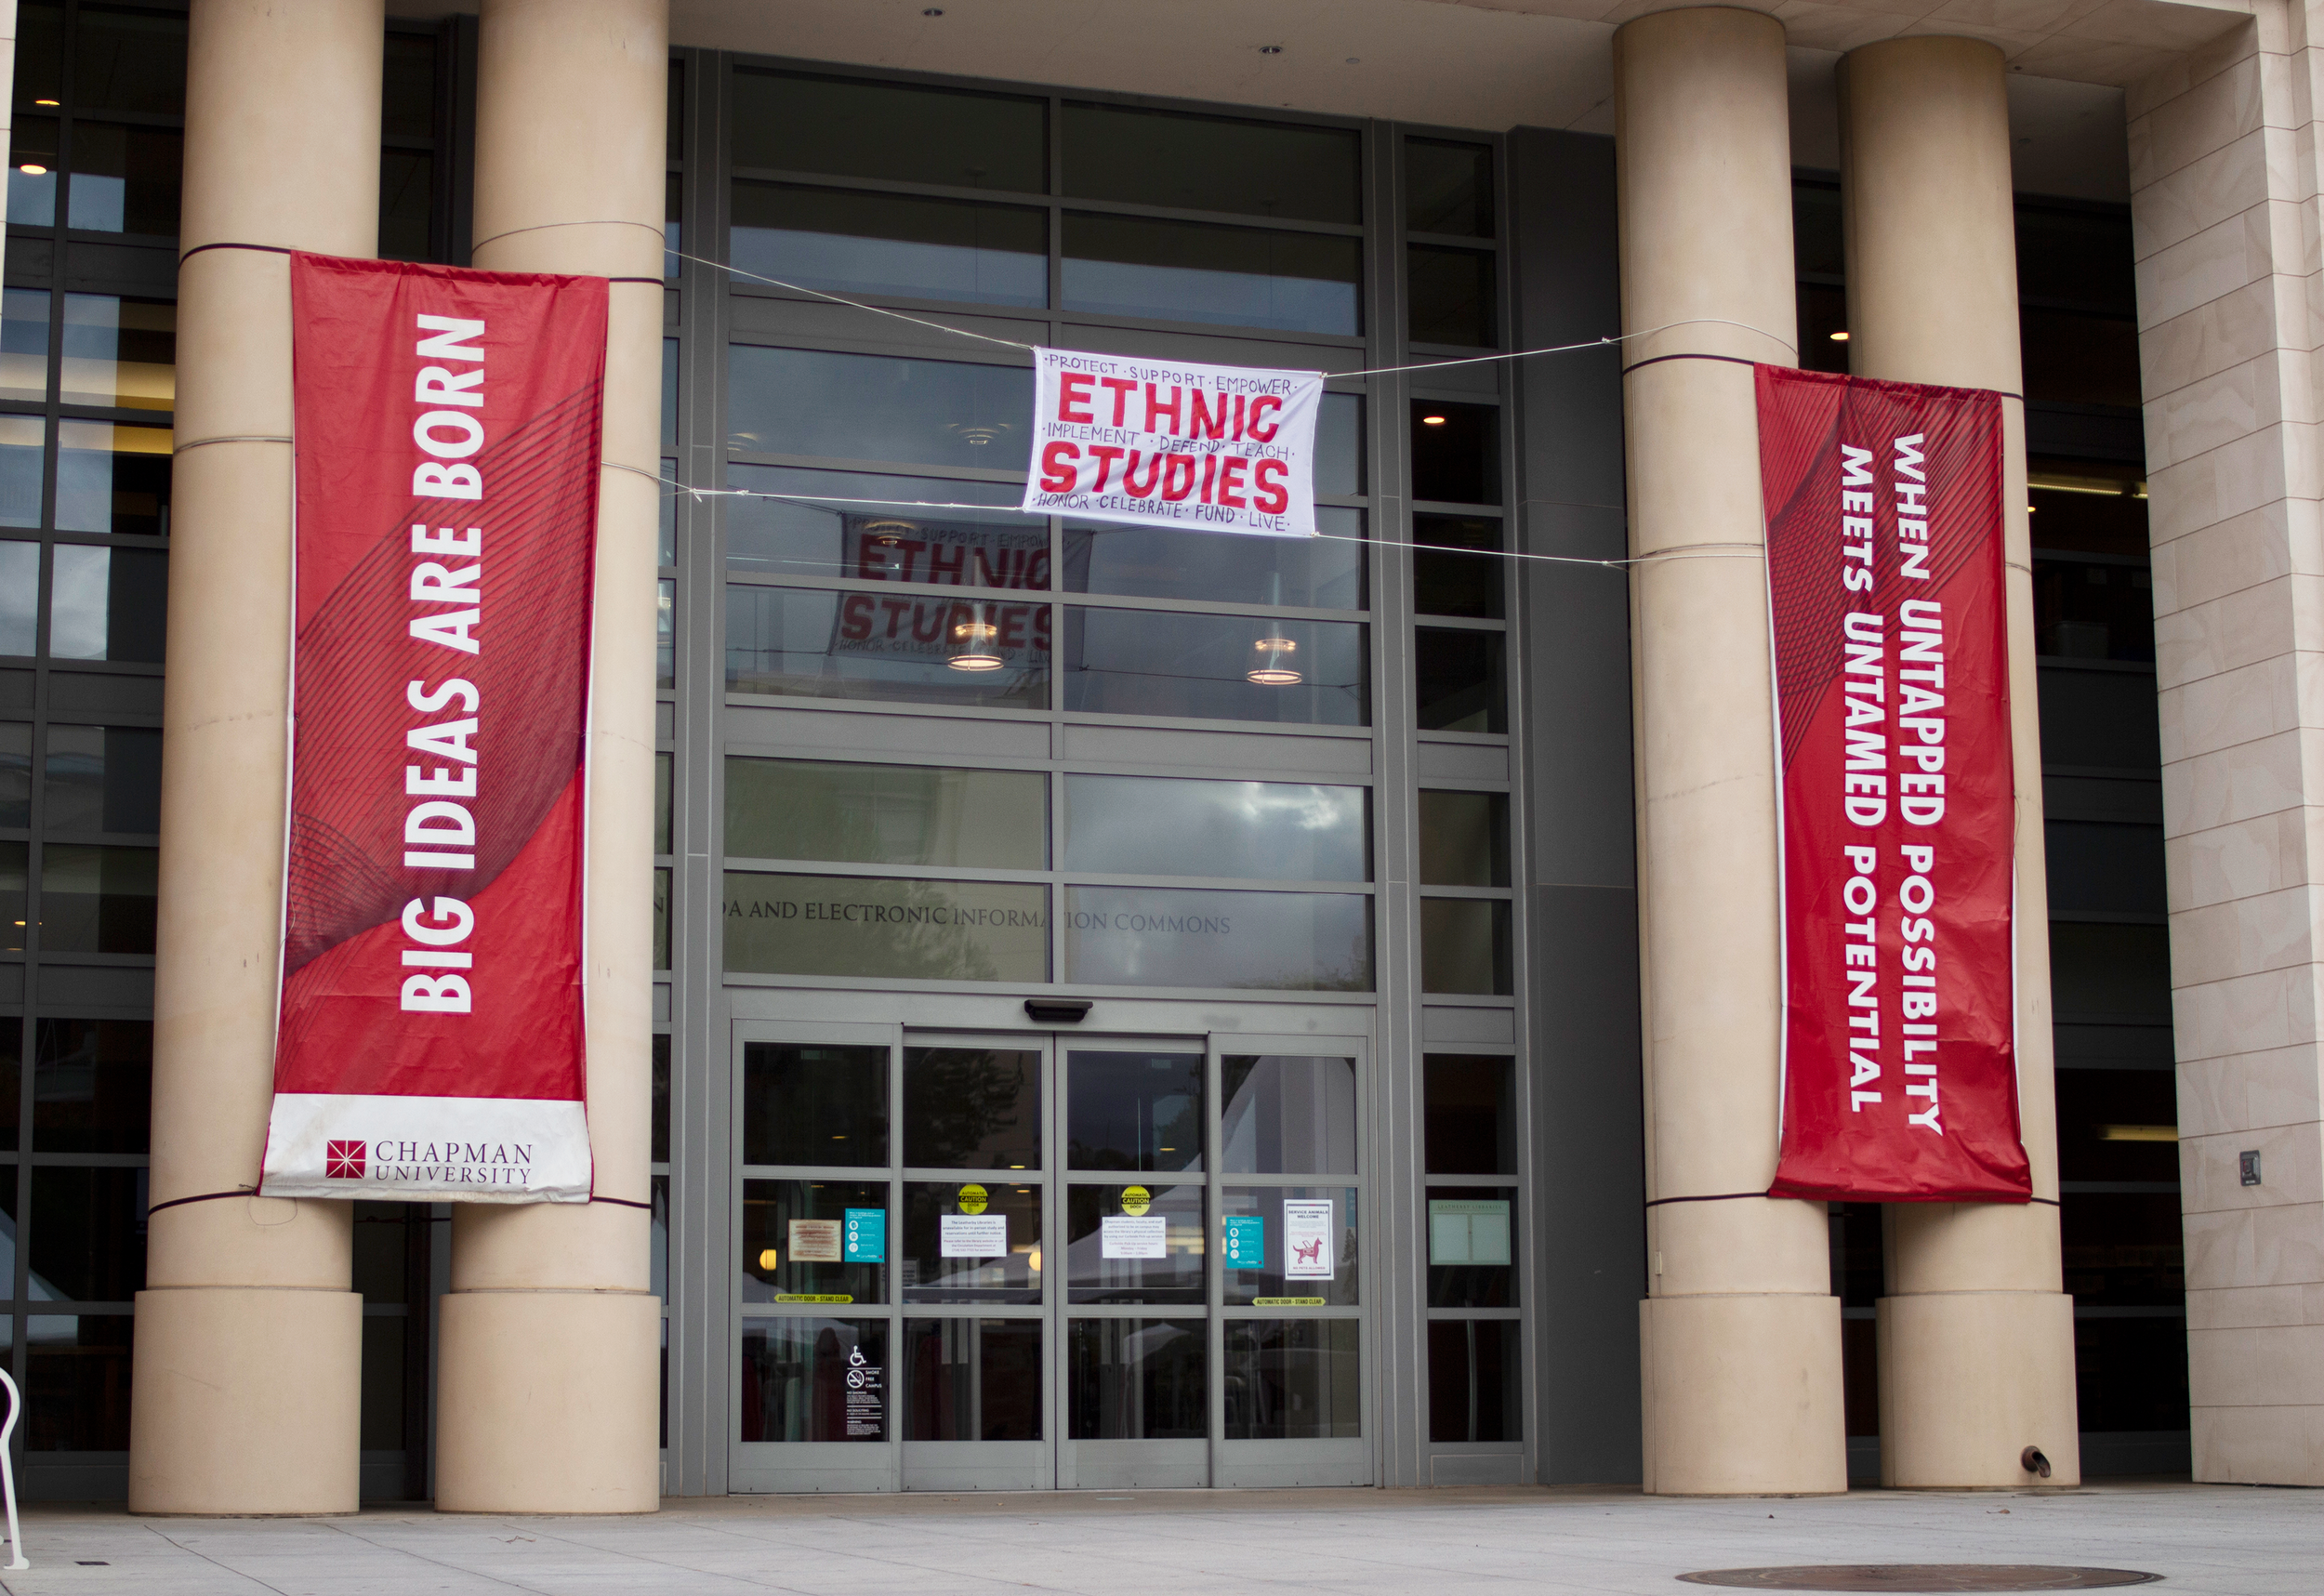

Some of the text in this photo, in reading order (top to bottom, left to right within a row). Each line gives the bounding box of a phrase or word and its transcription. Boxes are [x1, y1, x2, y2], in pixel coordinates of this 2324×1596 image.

[1050, 354, 1291, 395] PROTECT SUPPORT EMPOWER
[1058, 371, 1282, 443] ETHNIC
[1047, 422, 1288, 459] IMPLEMENT DEFEND TEACH
[1039, 441, 1289, 515] STUDIES
[1037, 494, 1286, 532] HONOR CELEBRATE FUND LIVE
[402, 314, 484, 1012] BIG IDEAS ARE BORN
[1842, 444, 1886, 1112] MEETS UNTAMED POTENTIAL
[1895, 433, 1944, 1135] WHEN UNTAPPED POSSIBILITY
[749, 901, 798, 919] AND
[805, 903, 947, 925] ELECTRONIC
[953, 908, 1107, 930] INFORMION
[1116, 913, 1231, 934] COMMONS
[376, 1141, 534, 1165] CHAPMAN
[375, 1165, 533, 1184] UNIVERSITY
